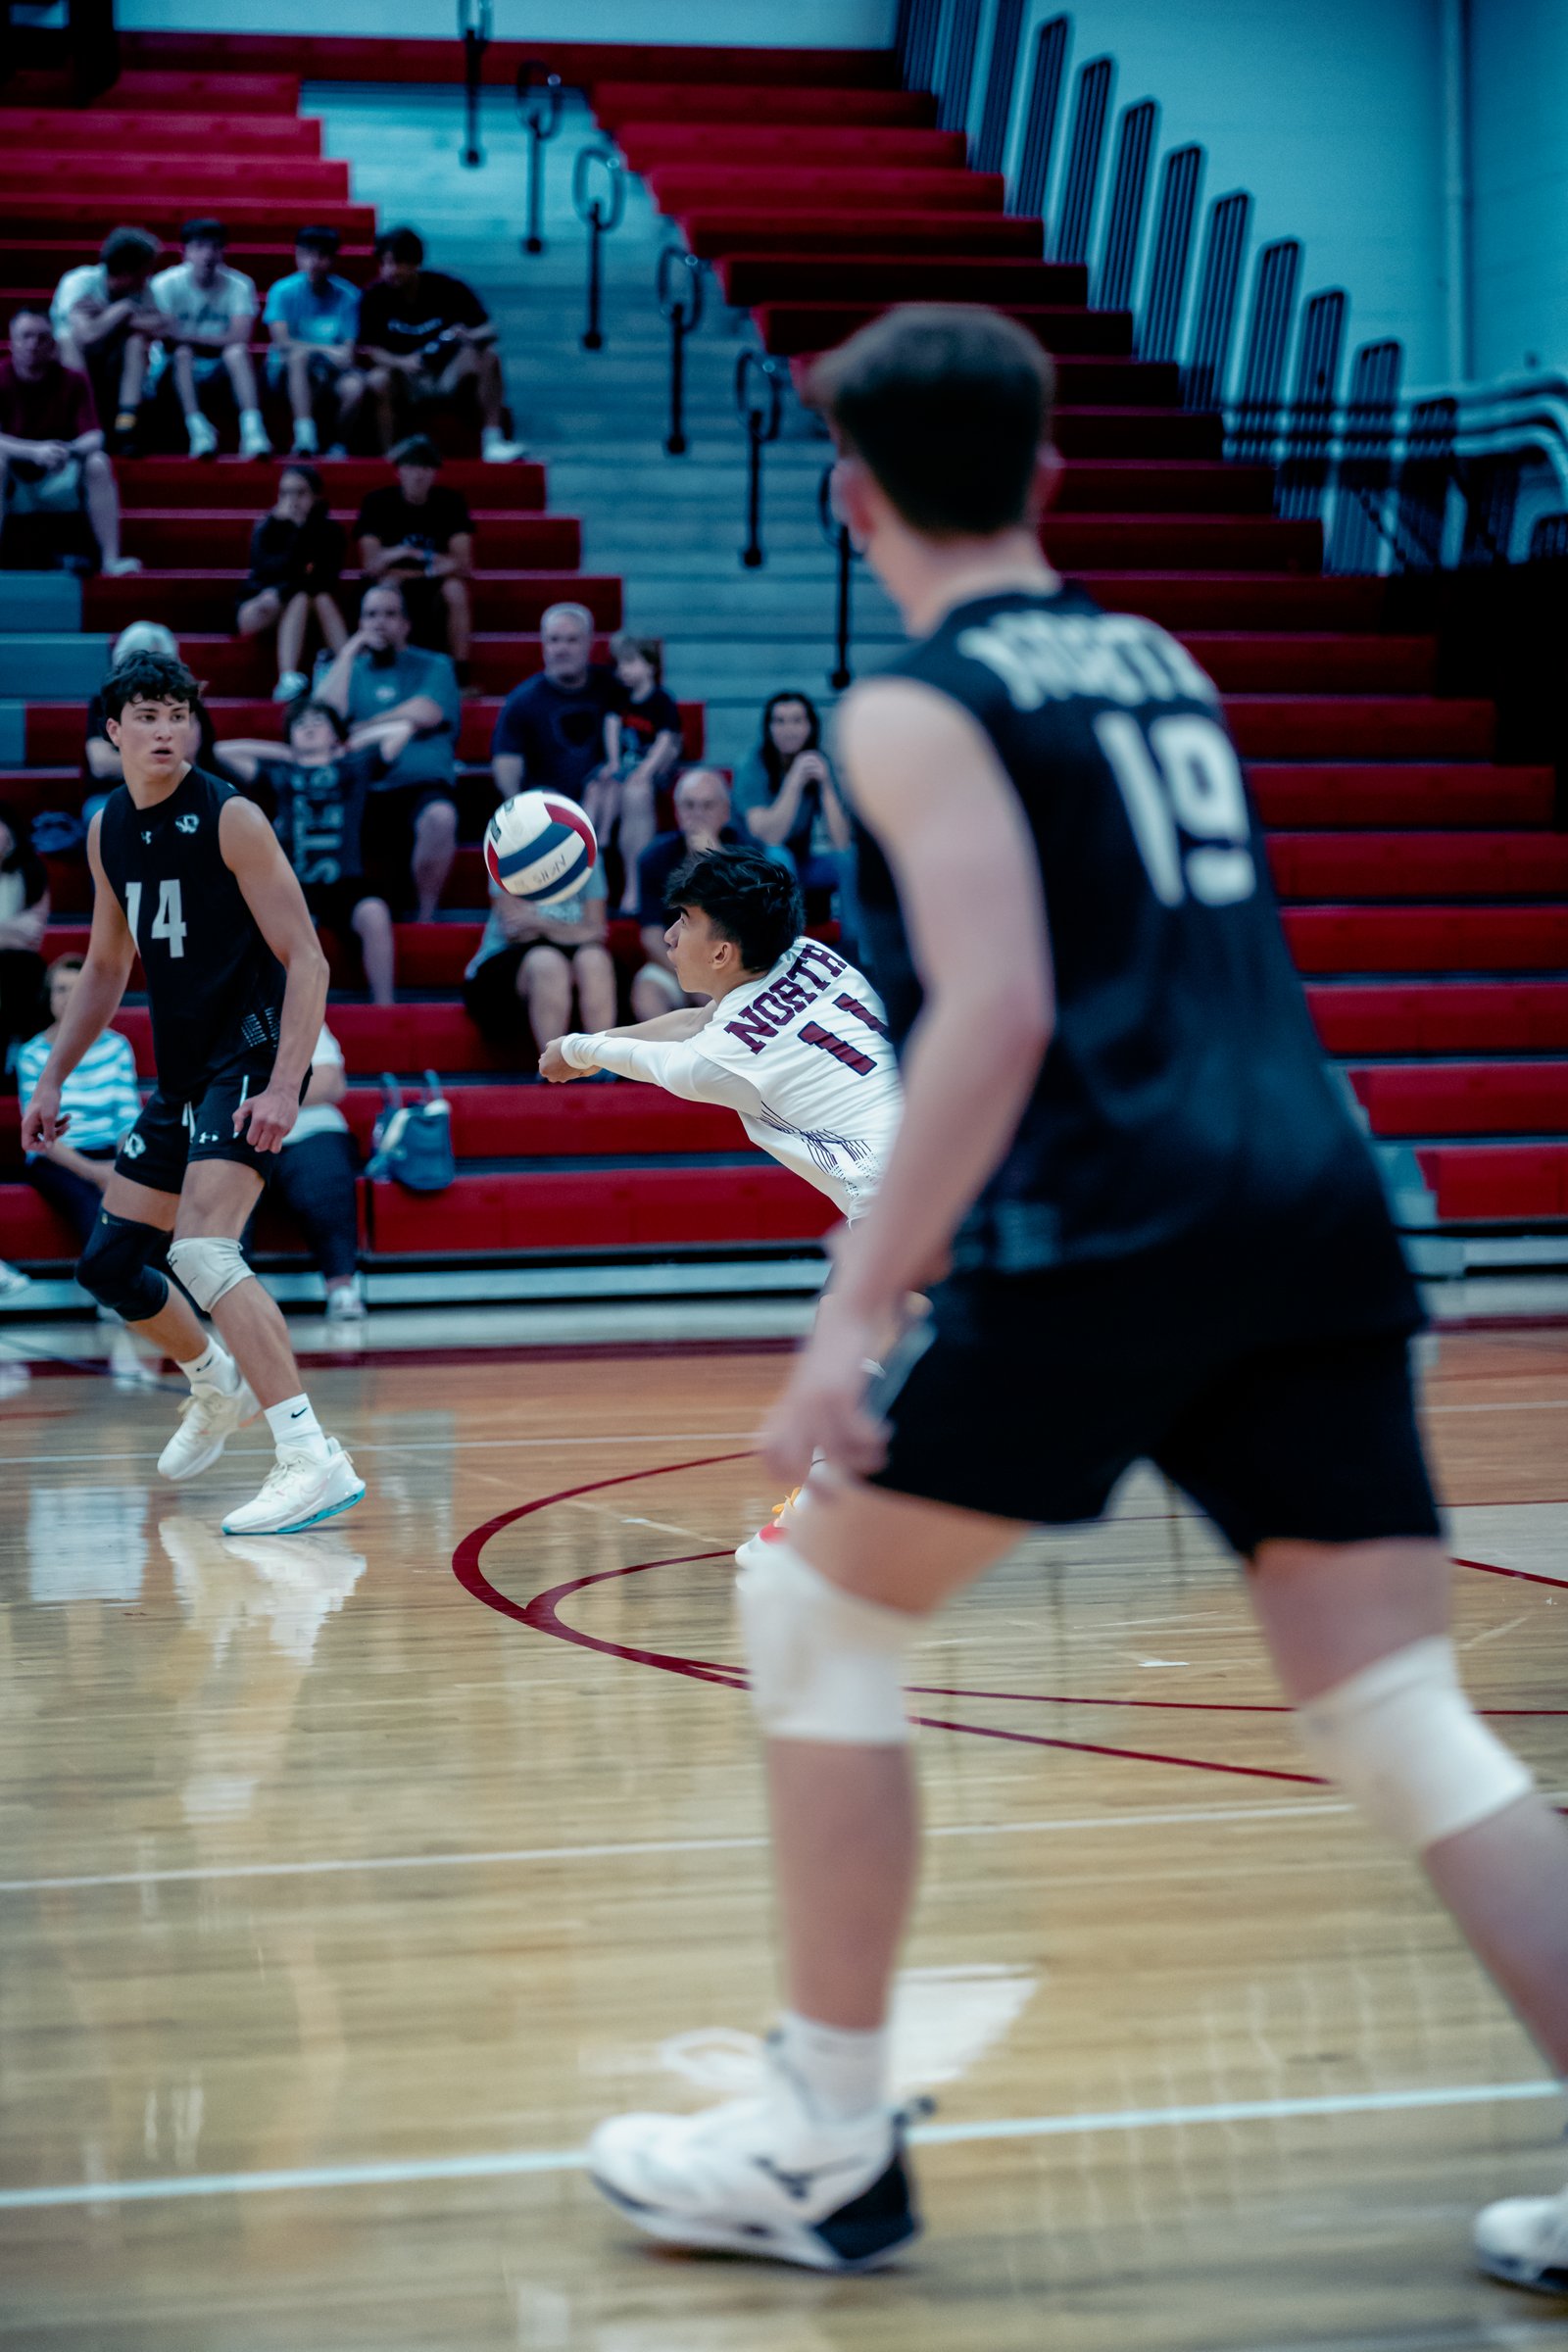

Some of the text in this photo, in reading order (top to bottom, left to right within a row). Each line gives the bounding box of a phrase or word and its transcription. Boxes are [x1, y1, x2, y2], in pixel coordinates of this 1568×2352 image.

[1092, 711, 1256, 907] 19
[125, 879, 187, 958] 14
[723, 944, 848, 1055] NORTH
[797, 992, 889, 1077] 11
